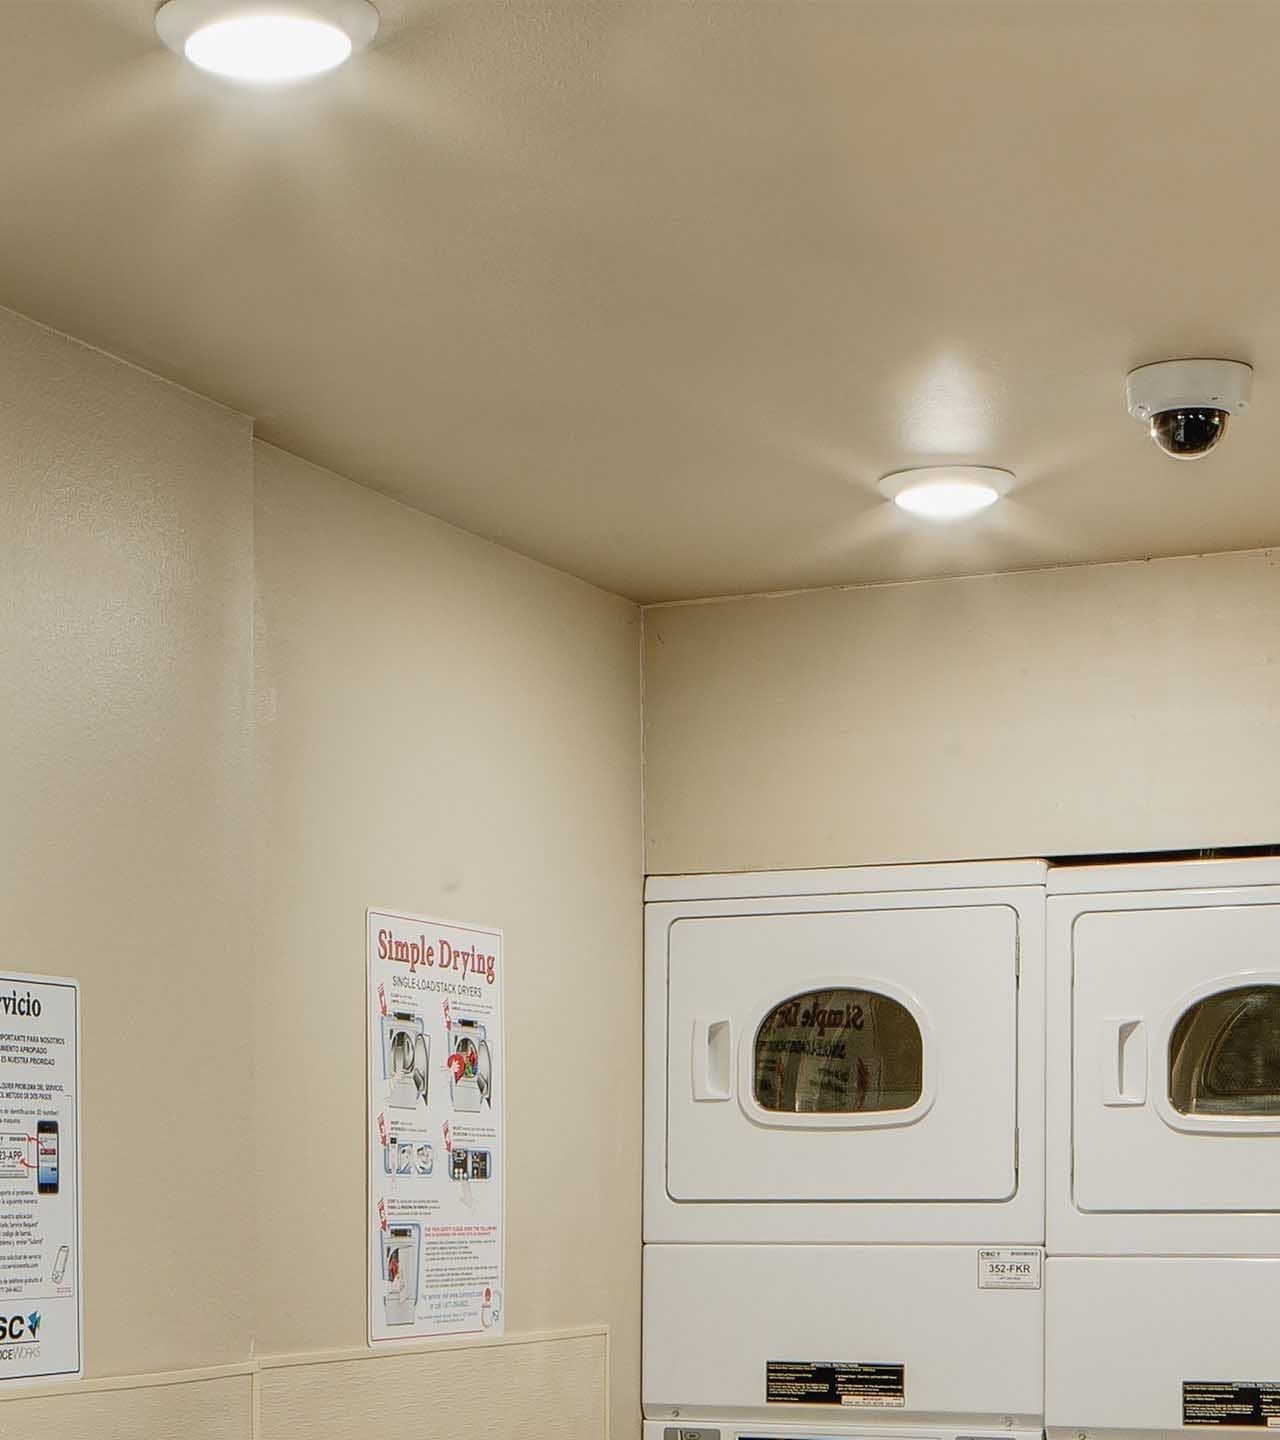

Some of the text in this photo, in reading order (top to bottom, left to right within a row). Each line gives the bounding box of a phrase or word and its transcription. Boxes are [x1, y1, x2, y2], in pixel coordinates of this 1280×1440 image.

[378, 929, 495, 984] Simple Drying
[458, 984, 482, 998] DRYERS
[989, 1264, 1031, 1273] 352-FKR
